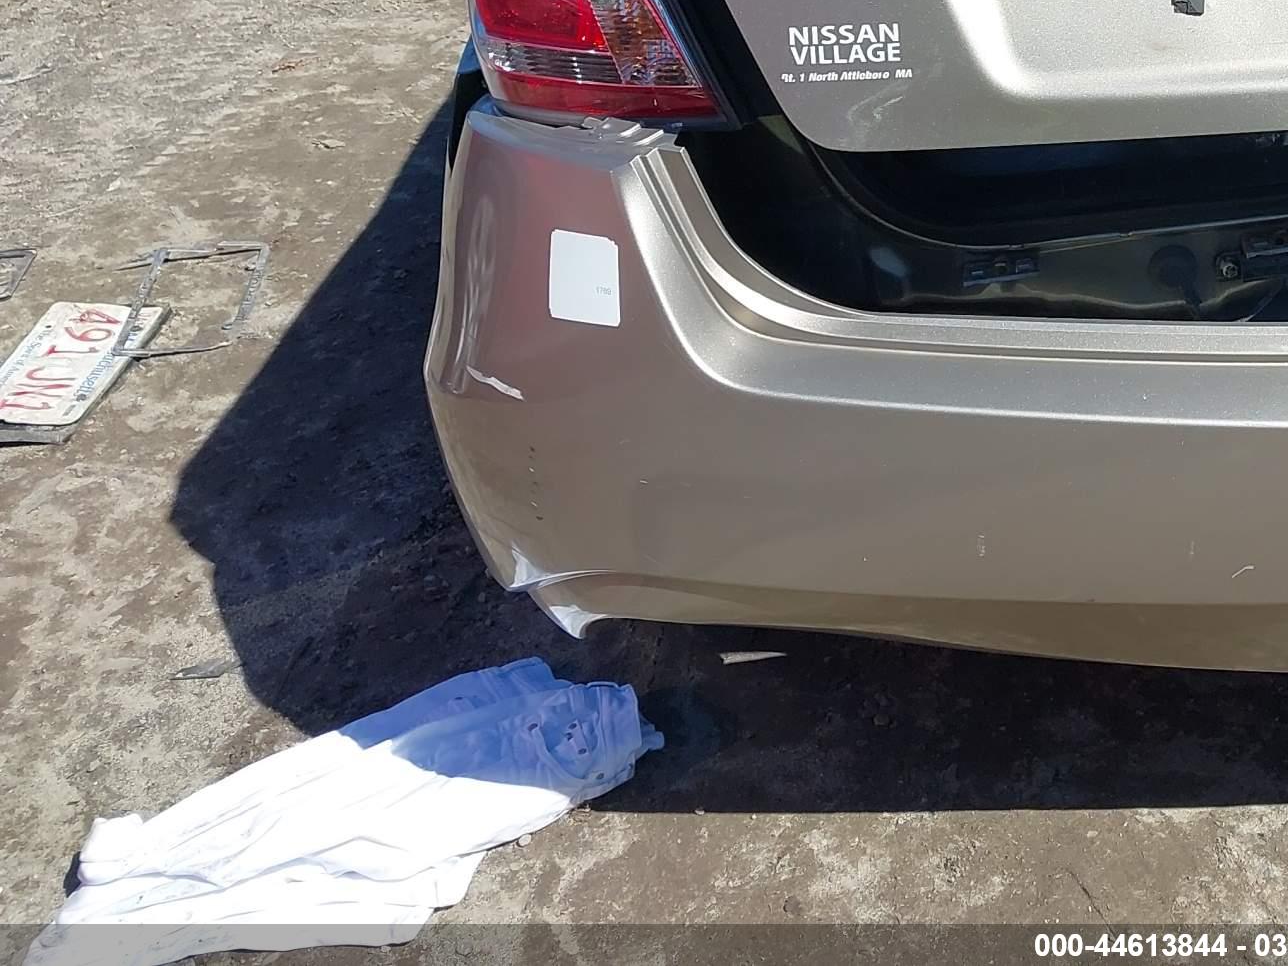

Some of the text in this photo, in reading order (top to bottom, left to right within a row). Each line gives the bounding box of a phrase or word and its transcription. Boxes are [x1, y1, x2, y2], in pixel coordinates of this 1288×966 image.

[788, 23, 900, 46] NISSAN
[790, 42, 901, 66] VILLAGE
[808, 71, 839, 82] North
[895, 68, 913, 78] MA
[43, 308, 121, 355] 491
